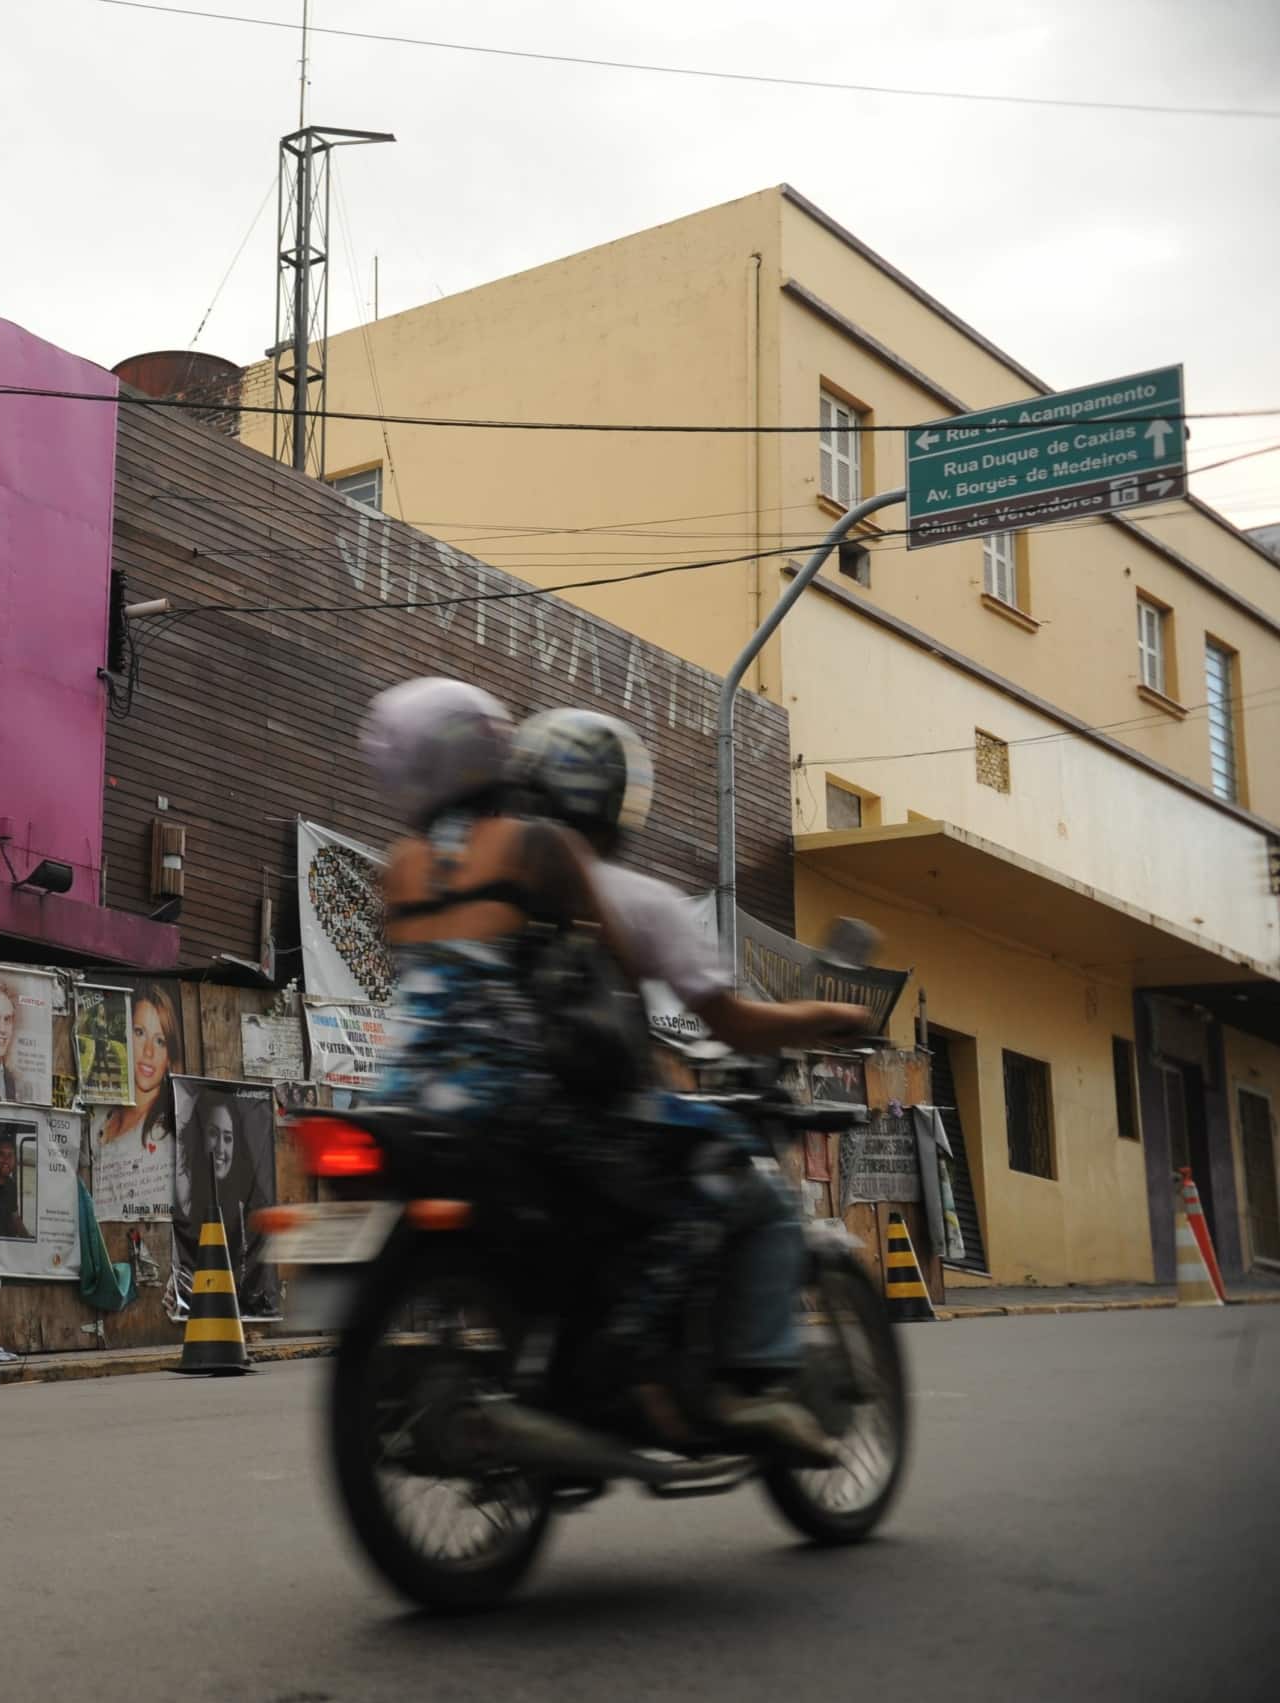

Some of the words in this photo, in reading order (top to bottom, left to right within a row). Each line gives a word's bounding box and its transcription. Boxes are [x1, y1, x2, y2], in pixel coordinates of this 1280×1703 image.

[1018, 384, 1158, 426] Acampamento
[943, 460, 979, 478] Rua
[982, 446, 1039, 472] Duque
[1047, 439, 1070, 455] de
[1073, 425, 1137, 450] Caxias
[926, 487, 952, 504] Av.
[956, 474, 1018, 498] Borges
[1026, 467, 1048, 483] de
[1053, 448, 1139, 478] Medeiros
[651, 1013, 700, 1033] estejam!
